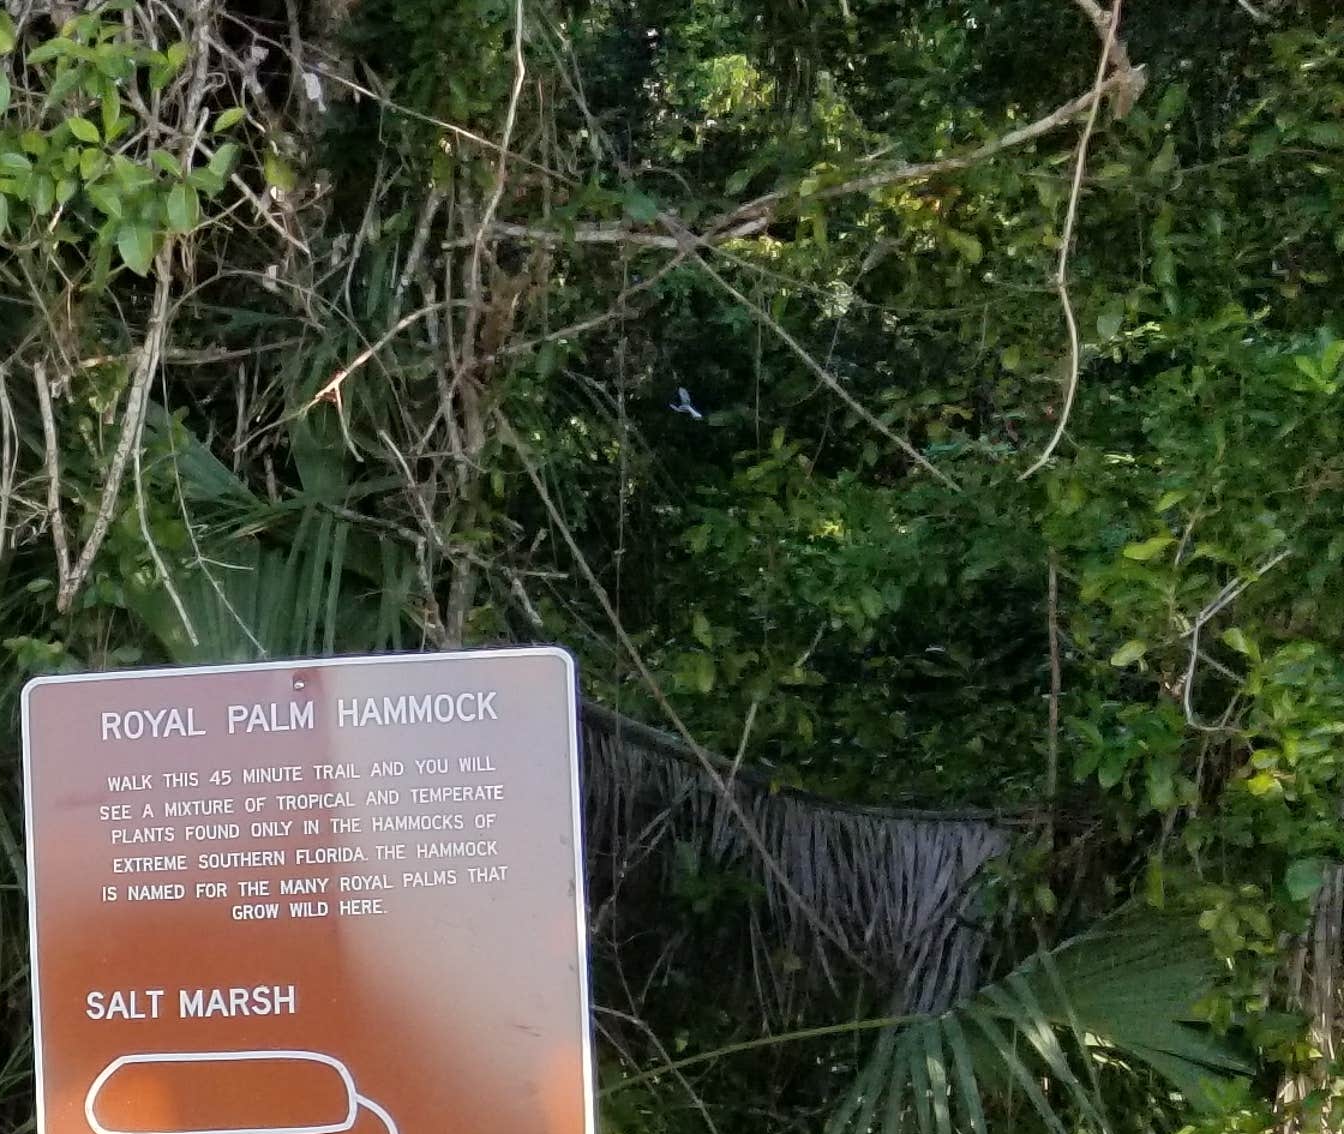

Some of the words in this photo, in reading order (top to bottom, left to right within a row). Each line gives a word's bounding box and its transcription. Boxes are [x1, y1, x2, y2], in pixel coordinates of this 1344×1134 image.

[101, 708, 206, 740] ROYAL
[227, 701, 314, 735] PALM
[338, 692, 498, 727] HAMMOCK
[108, 775, 153, 791] WALK
[163, 772, 199, 788] THIS
[209, 769, 232, 785] 45
[243, 765, 303, 783] MINUTE
[313, 763, 361, 780] TRAIL
[371, 760, 404, 777] AND
[415, 759, 449, 775] YOU
[459, 756, 495, 772] WILL
[100, 804, 132, 821] SEE
[142, 802, 154, 818] A
[164, 798, 234, 816] MIXTURE
[244, 796, 266, 812] OF
[276, 792, 356, 810] TROPICAL
[366, 789, 400, 805] AND
[410, 784, 504, 804] TEMPERATE
[111, 826, 175, 844] PLANTS
[185, 823, 240, 841] FOUND
[251, 820, 293, 837] ONLY
[303, 819, 320, 835] IN
[330, 817, 362, 834] THE
[372, 813, 464, 832] HAMMOCKS
[475, 813, 497, 828] OF
[113, 854, 187, 873] EXTREME
[198, 850, 285, 870] SOUTHERN
[296, 845, 368, 865] FLORIDA.
[376, 843, 407, 860] THE
[416, 840, 498, 858] HAMMOCK
[102, 886, 117, 902] IS
[127, 883, 185, 901] NAMED
[195, 881, 227, 898] FOR
[238, 880, 270, 896] THE
[279, 877, 329, 895] MANY
[339, 873, 394, 892] ROYAL
[402, 869, 457, 888] PALMS
[467, 865, 508, 883] THAT
[232, 903, 279, 921] GROW
[289, 902, 328, 918] WILD
[339, 899, 387, 916] HERE.
[86, 990, 164, 1020] SALT
[179, 985, 296, 1017] MARSH
